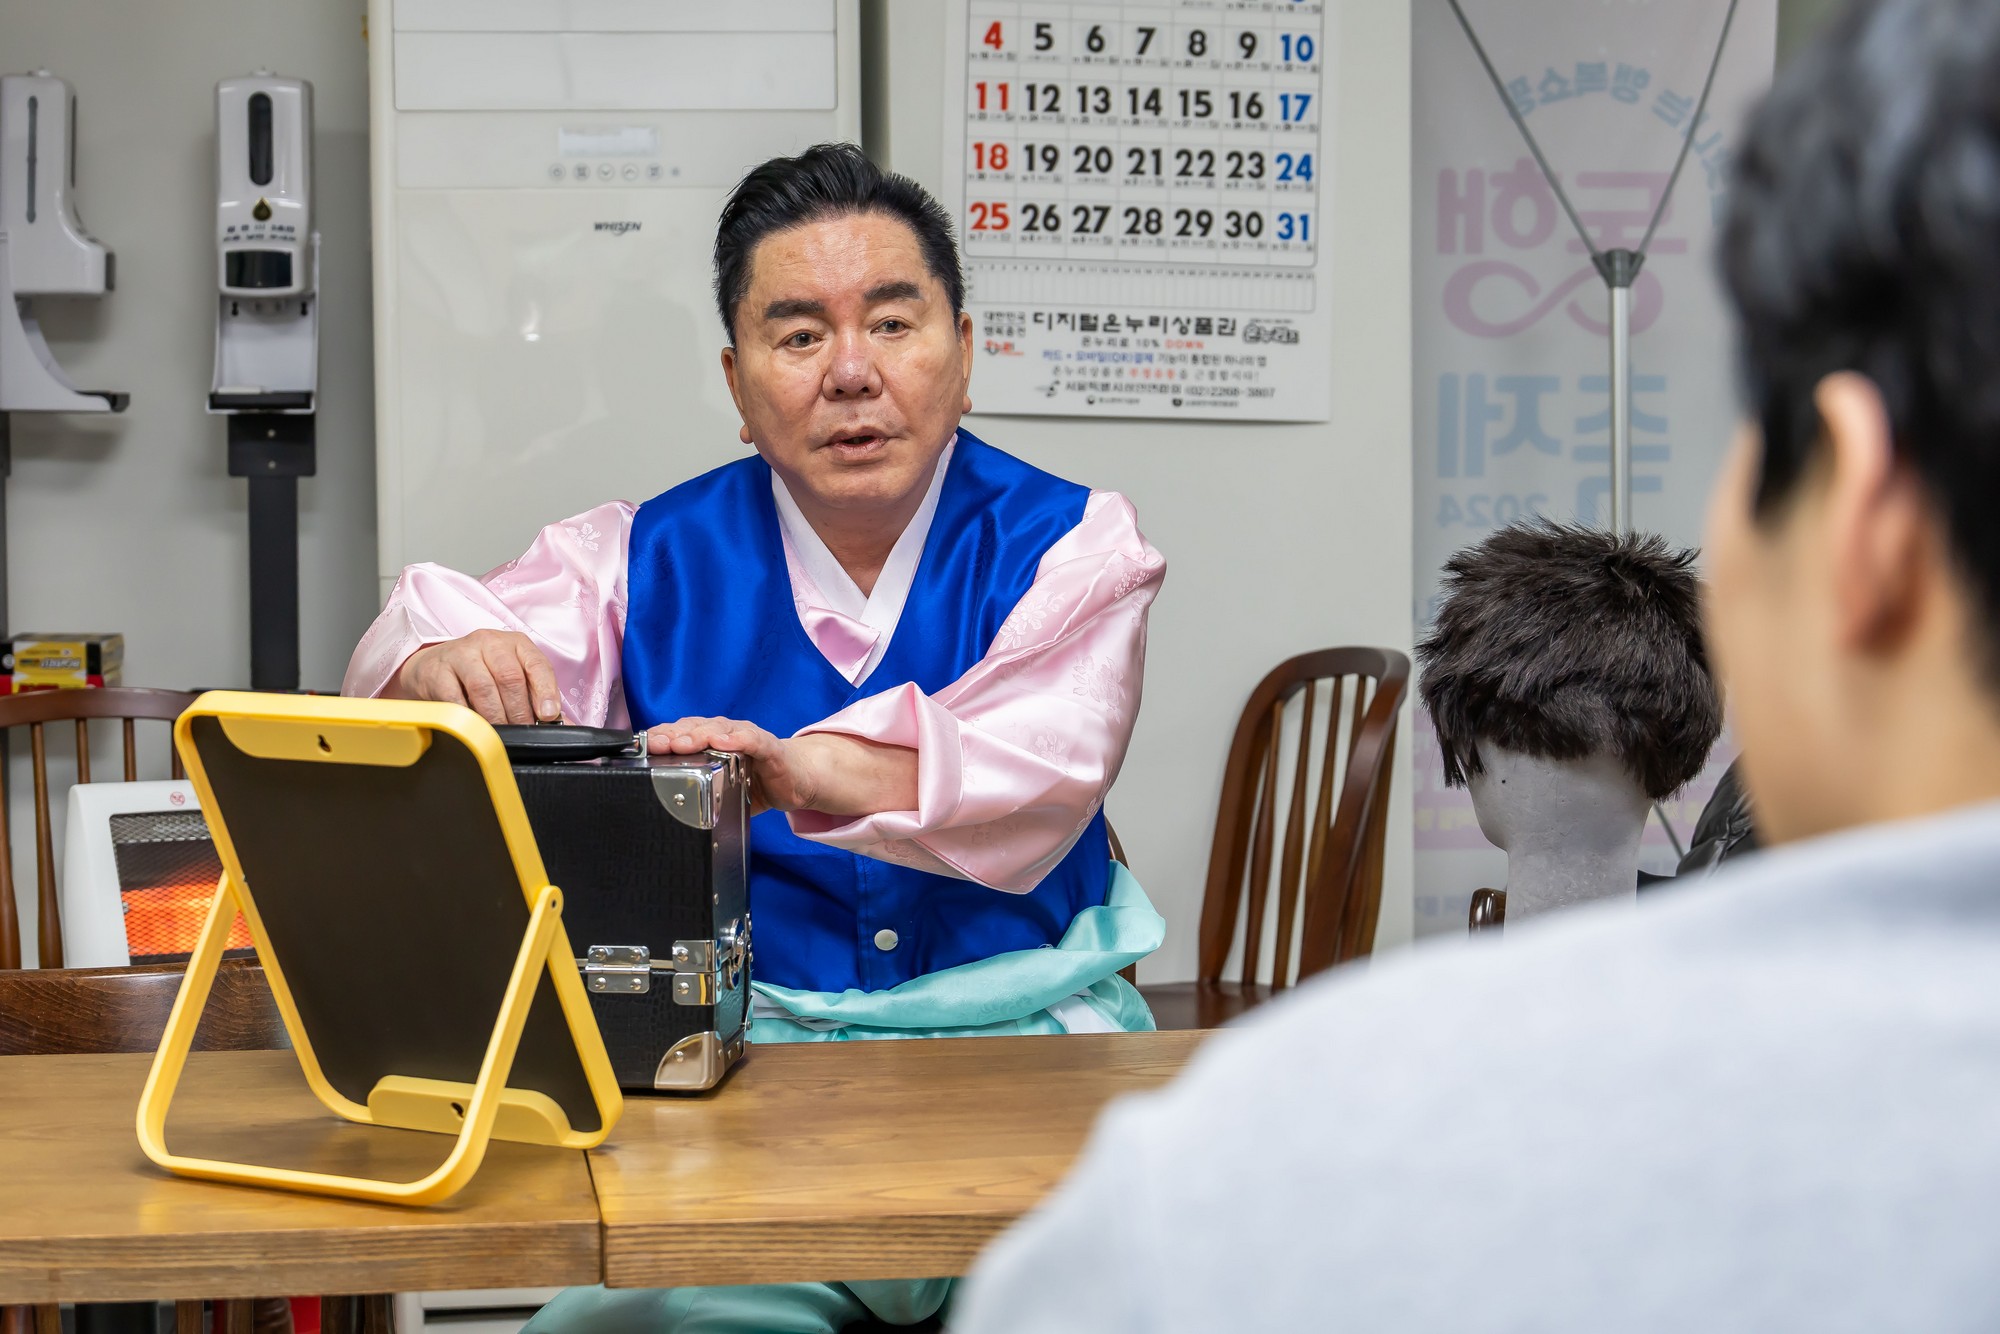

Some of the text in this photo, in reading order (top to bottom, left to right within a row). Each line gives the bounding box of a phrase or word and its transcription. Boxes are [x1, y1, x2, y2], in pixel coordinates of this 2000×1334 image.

[984, 21, 1314, 63] 4 5 6 7 8 9 10
[975, 81, 1312, 122] 11 12 13 14 15 16 17
[973, 142, 1313, 183] 18 19 20 21 22 23 24
[593, 221, 642, 234] WHISEN
[970, 202, 1309, 242] 25 26 27 28 29 30 31
[1033, 311, 1237, 337] 디지털온누리상품권
[1165, 340, 1205, 350] DOWN
